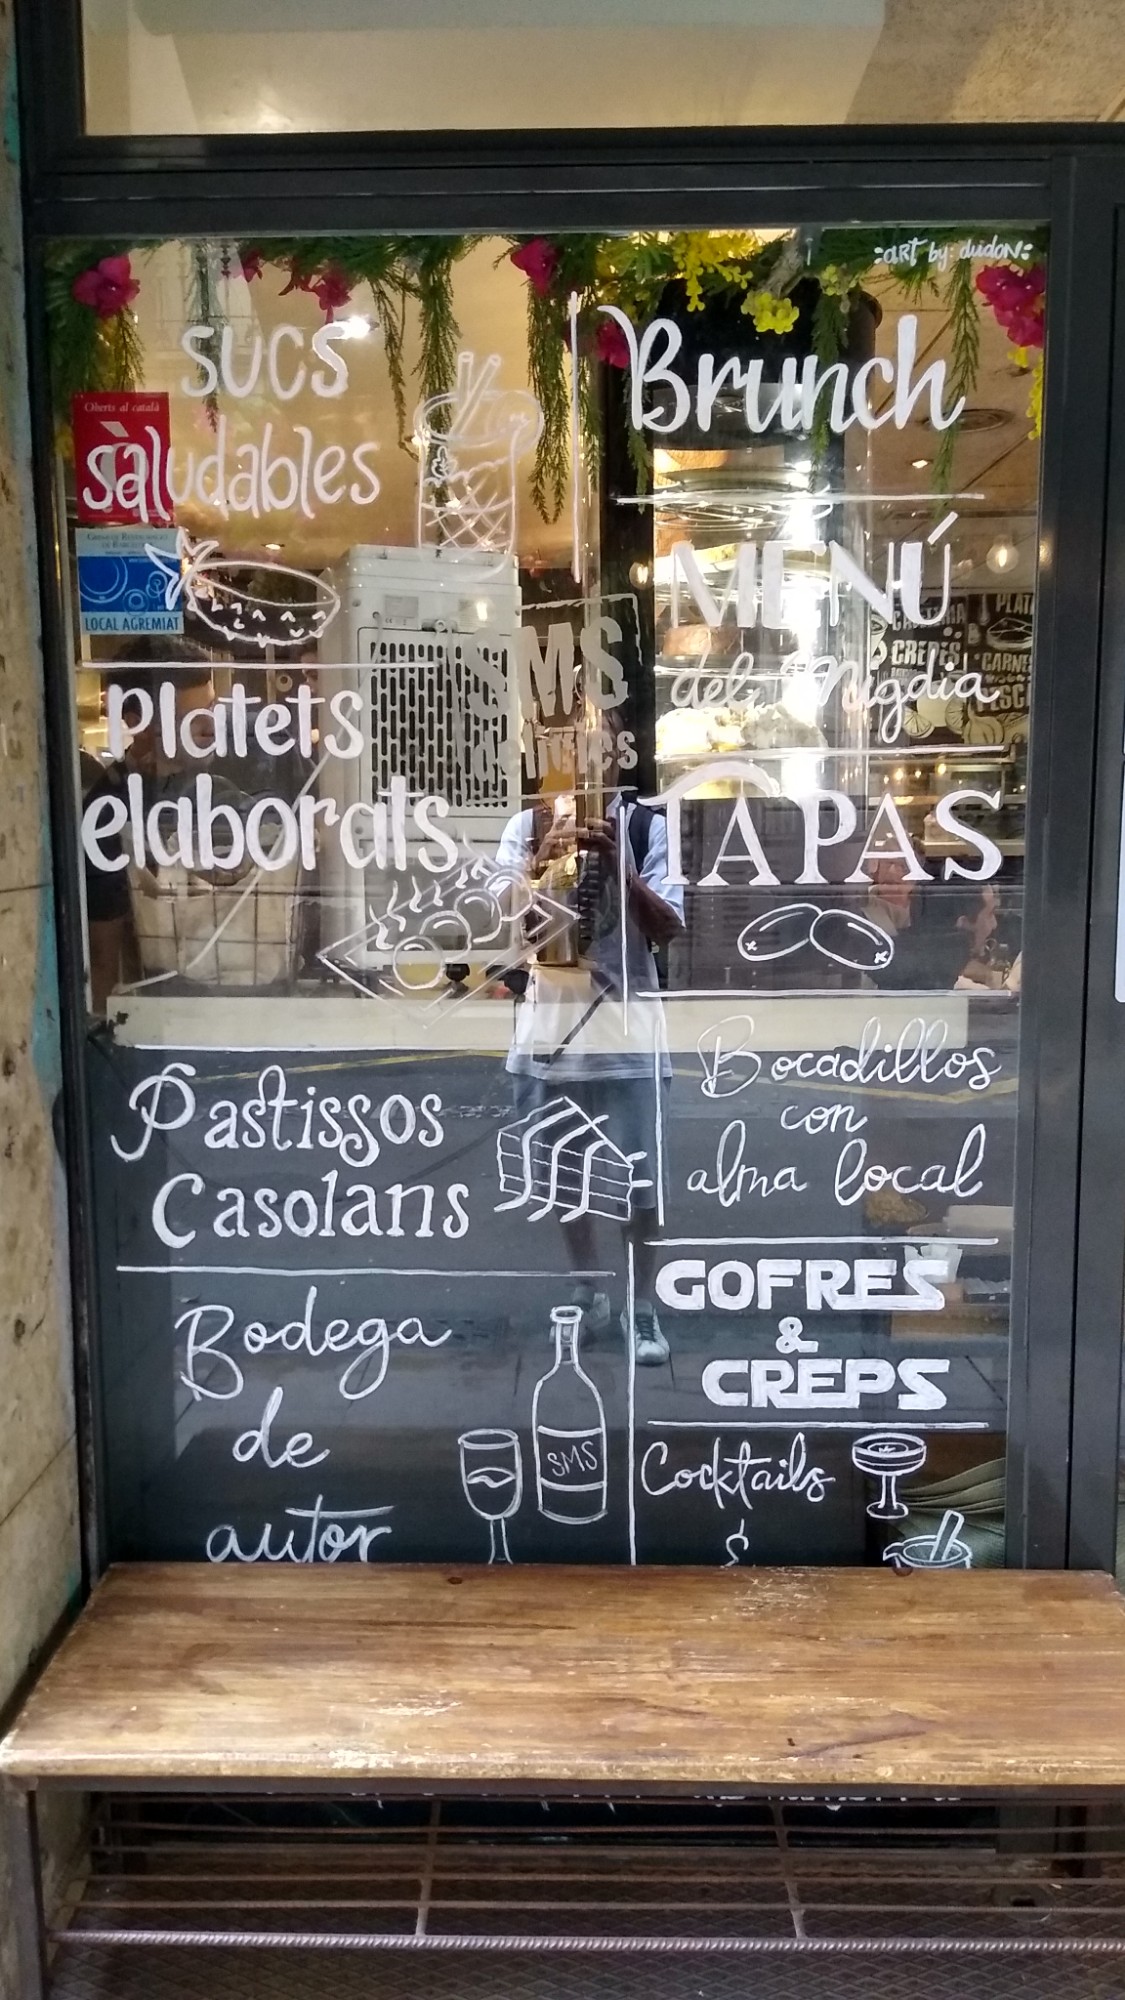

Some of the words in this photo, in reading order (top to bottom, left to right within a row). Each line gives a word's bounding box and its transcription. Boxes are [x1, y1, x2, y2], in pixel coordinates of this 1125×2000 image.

[597, 304, 966, 433] Brunch
[82, 414, 380, 522] saludables
[670, 511, 958, 628] MENÚ
[85, 617, 118, 632] LOCAL
[122, 617, 180, 632] AGREMIAT
[463, 615, 629, 720] SMS
[671, 647, 762, 709] del
[81, 773, 459, 872] elaborats
[637, 759, 1002, 886] TAPAS
[697, 1015, 1001, 1098] Bocadillos
[110, 1063, 444, 1168] Pastissos
[780, 1103, 868, 1134] con
[687, 1120, 807, 1207] alma
[835, 1123, 986, 1206] local
[152, 1170, 470, 1248] Casolans
[655, 1259, 949, 1311] GOFRES
[175, 1286, 452, 1401] Bodega
[775, 1316, 819, 1354] &
[701, 1358, 950, 1410] CREPS
[233, 1387, 330, 1468] de
[547, 1440, 599, 1477] SMS
[641, 1433, 835, 1511] Cocktails
[205, 1494, 395, 1563] autor
